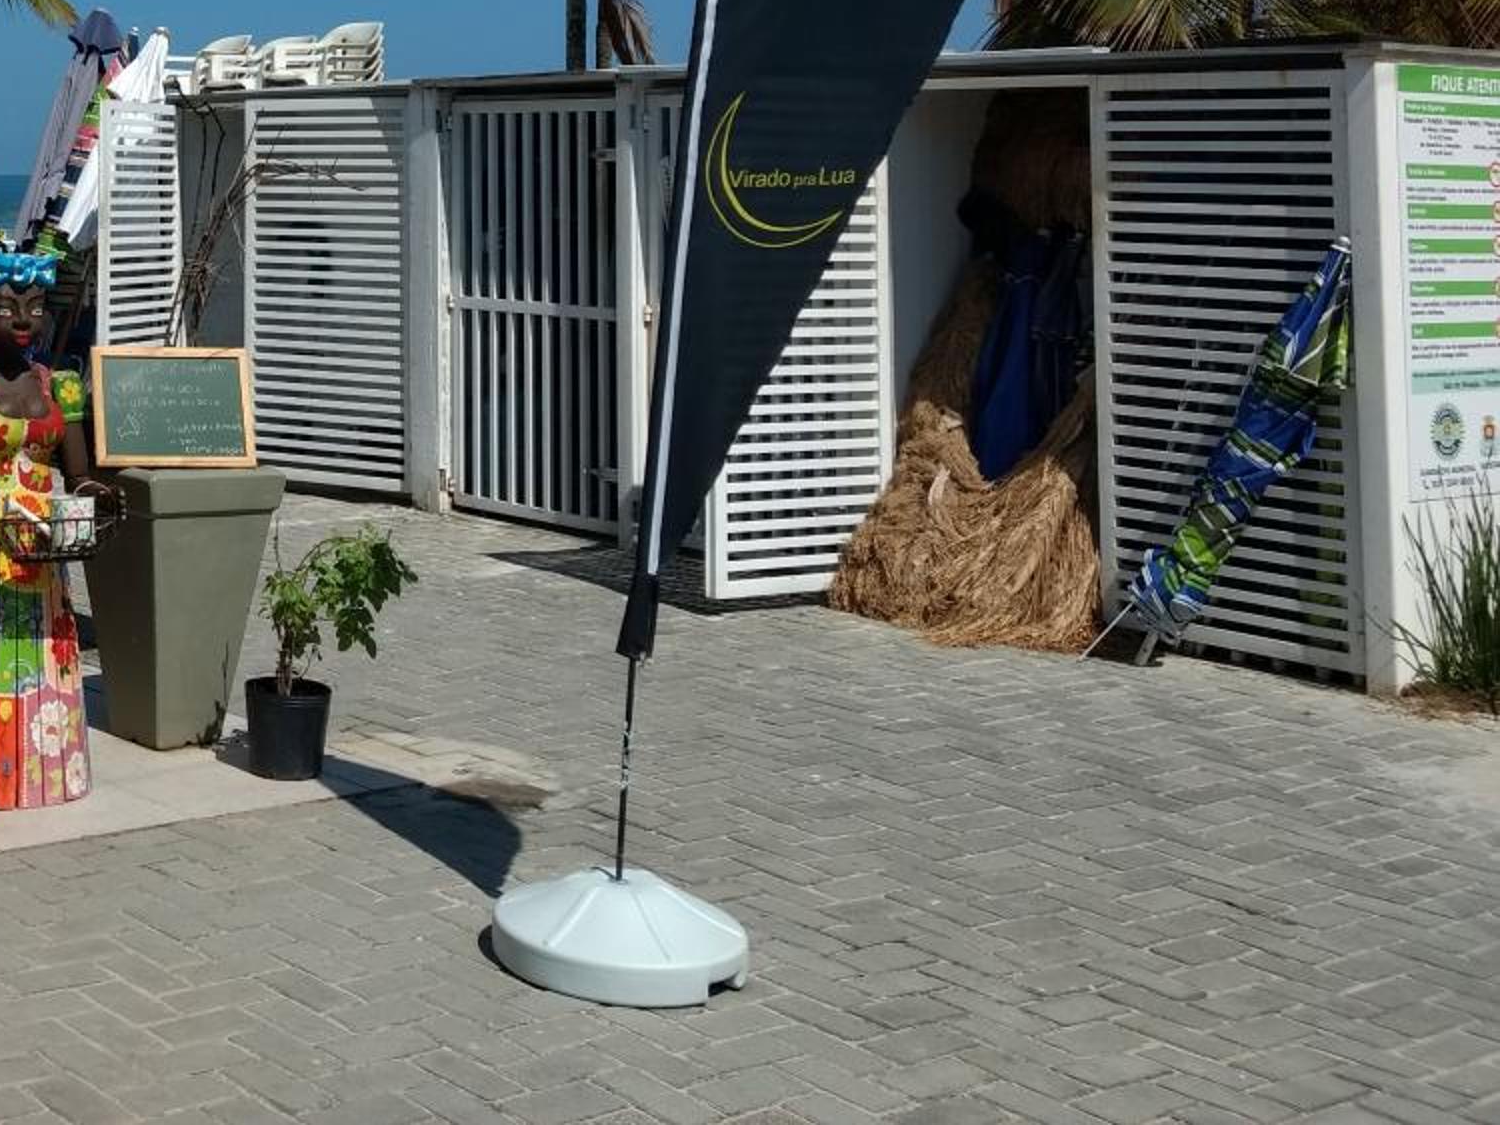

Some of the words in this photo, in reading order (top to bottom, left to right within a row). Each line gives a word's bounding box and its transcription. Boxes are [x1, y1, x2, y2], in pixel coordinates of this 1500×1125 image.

[1432, 75, 1464, 92] FIQUE
[730, 169, 791, 188] Virado
[819, 166, 855, 186] Lua
